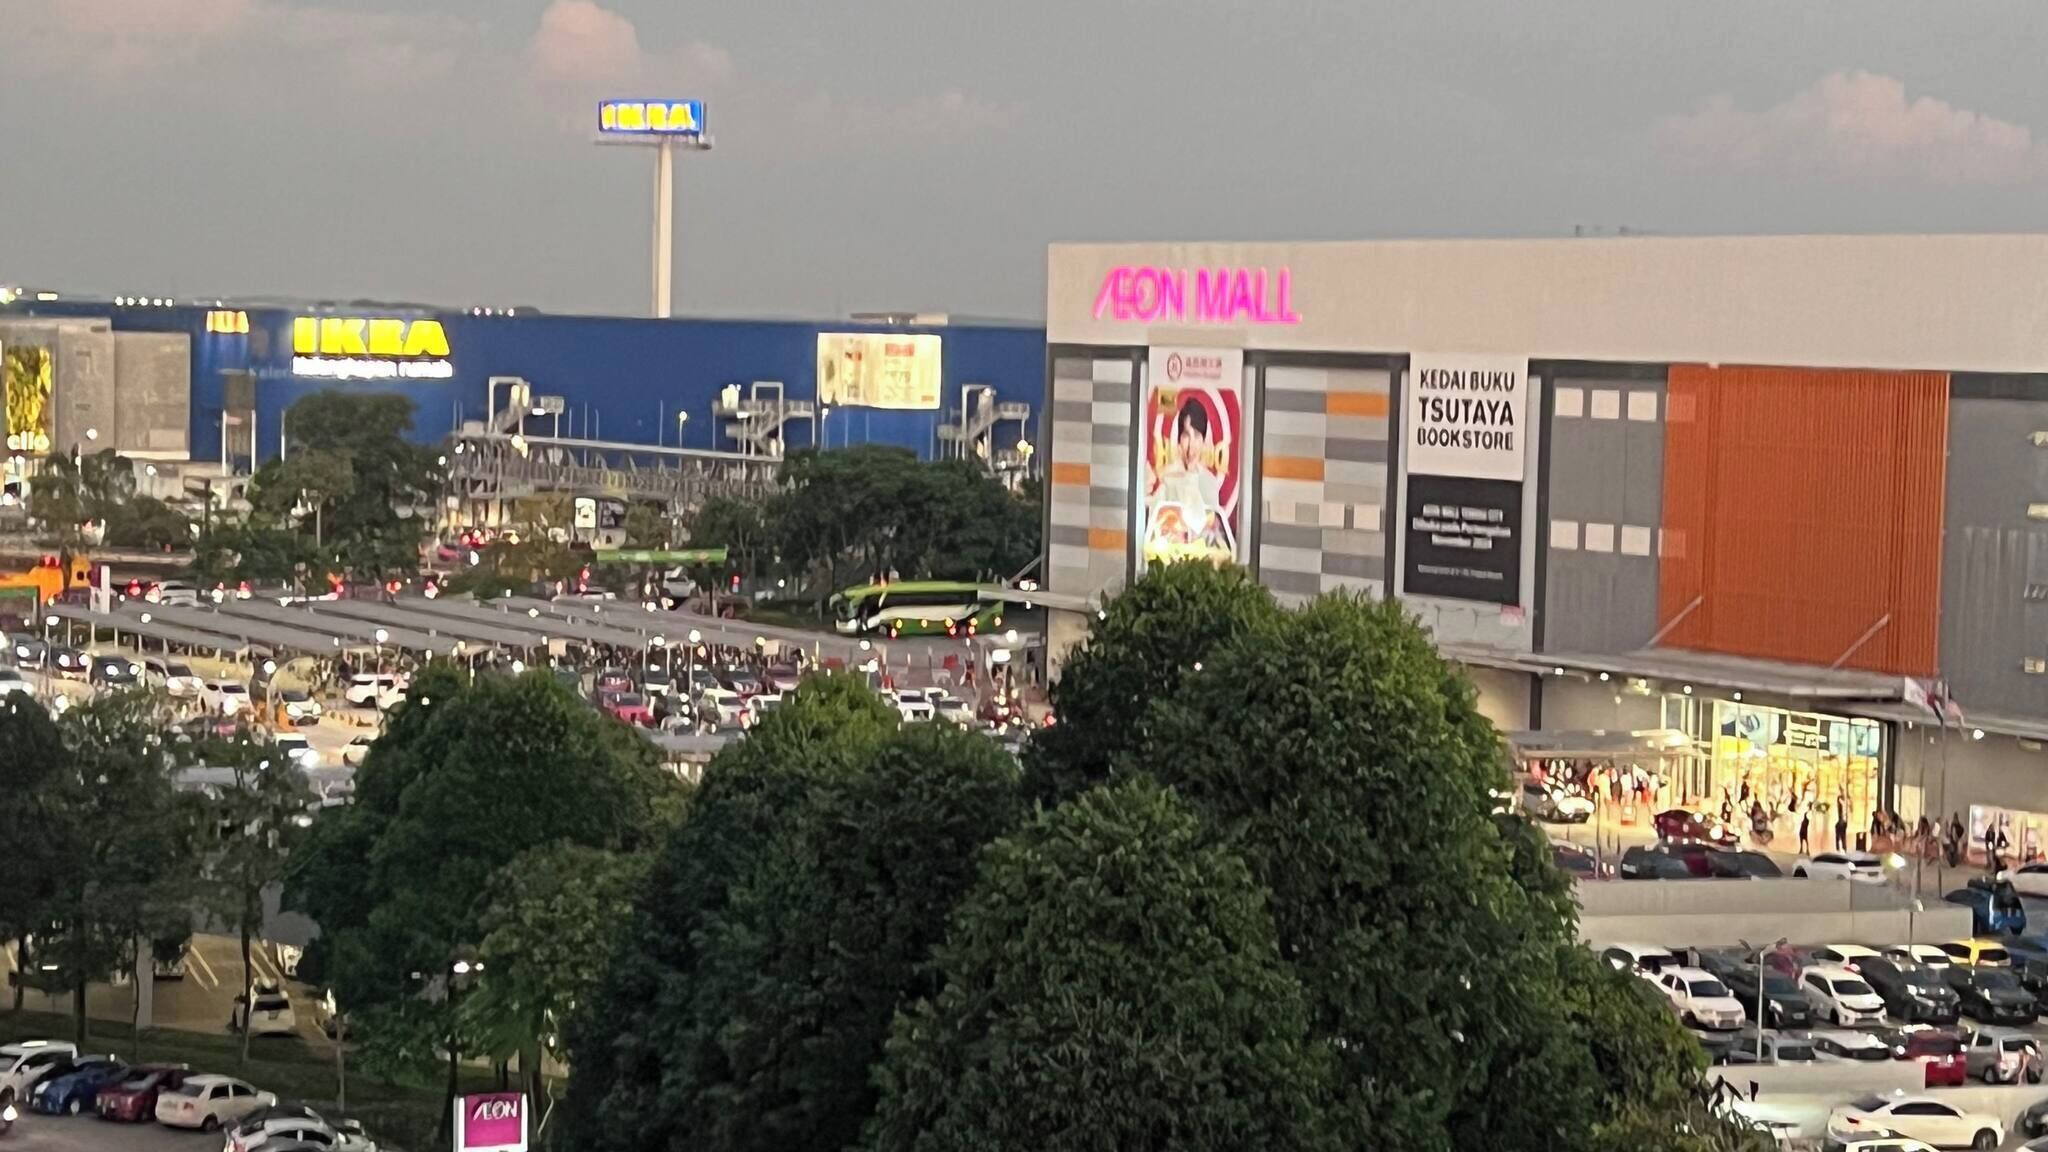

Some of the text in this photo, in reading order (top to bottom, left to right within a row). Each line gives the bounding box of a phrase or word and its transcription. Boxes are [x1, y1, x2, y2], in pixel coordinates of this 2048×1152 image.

[1196, 267, 1303, 324] MALL
[1420, 368, 1515, 392] KEDAI BUKU
[1418, 396, 1514, 427] TSUTAYA
[1417, 425, 1514, 451] BOOKSTORE
